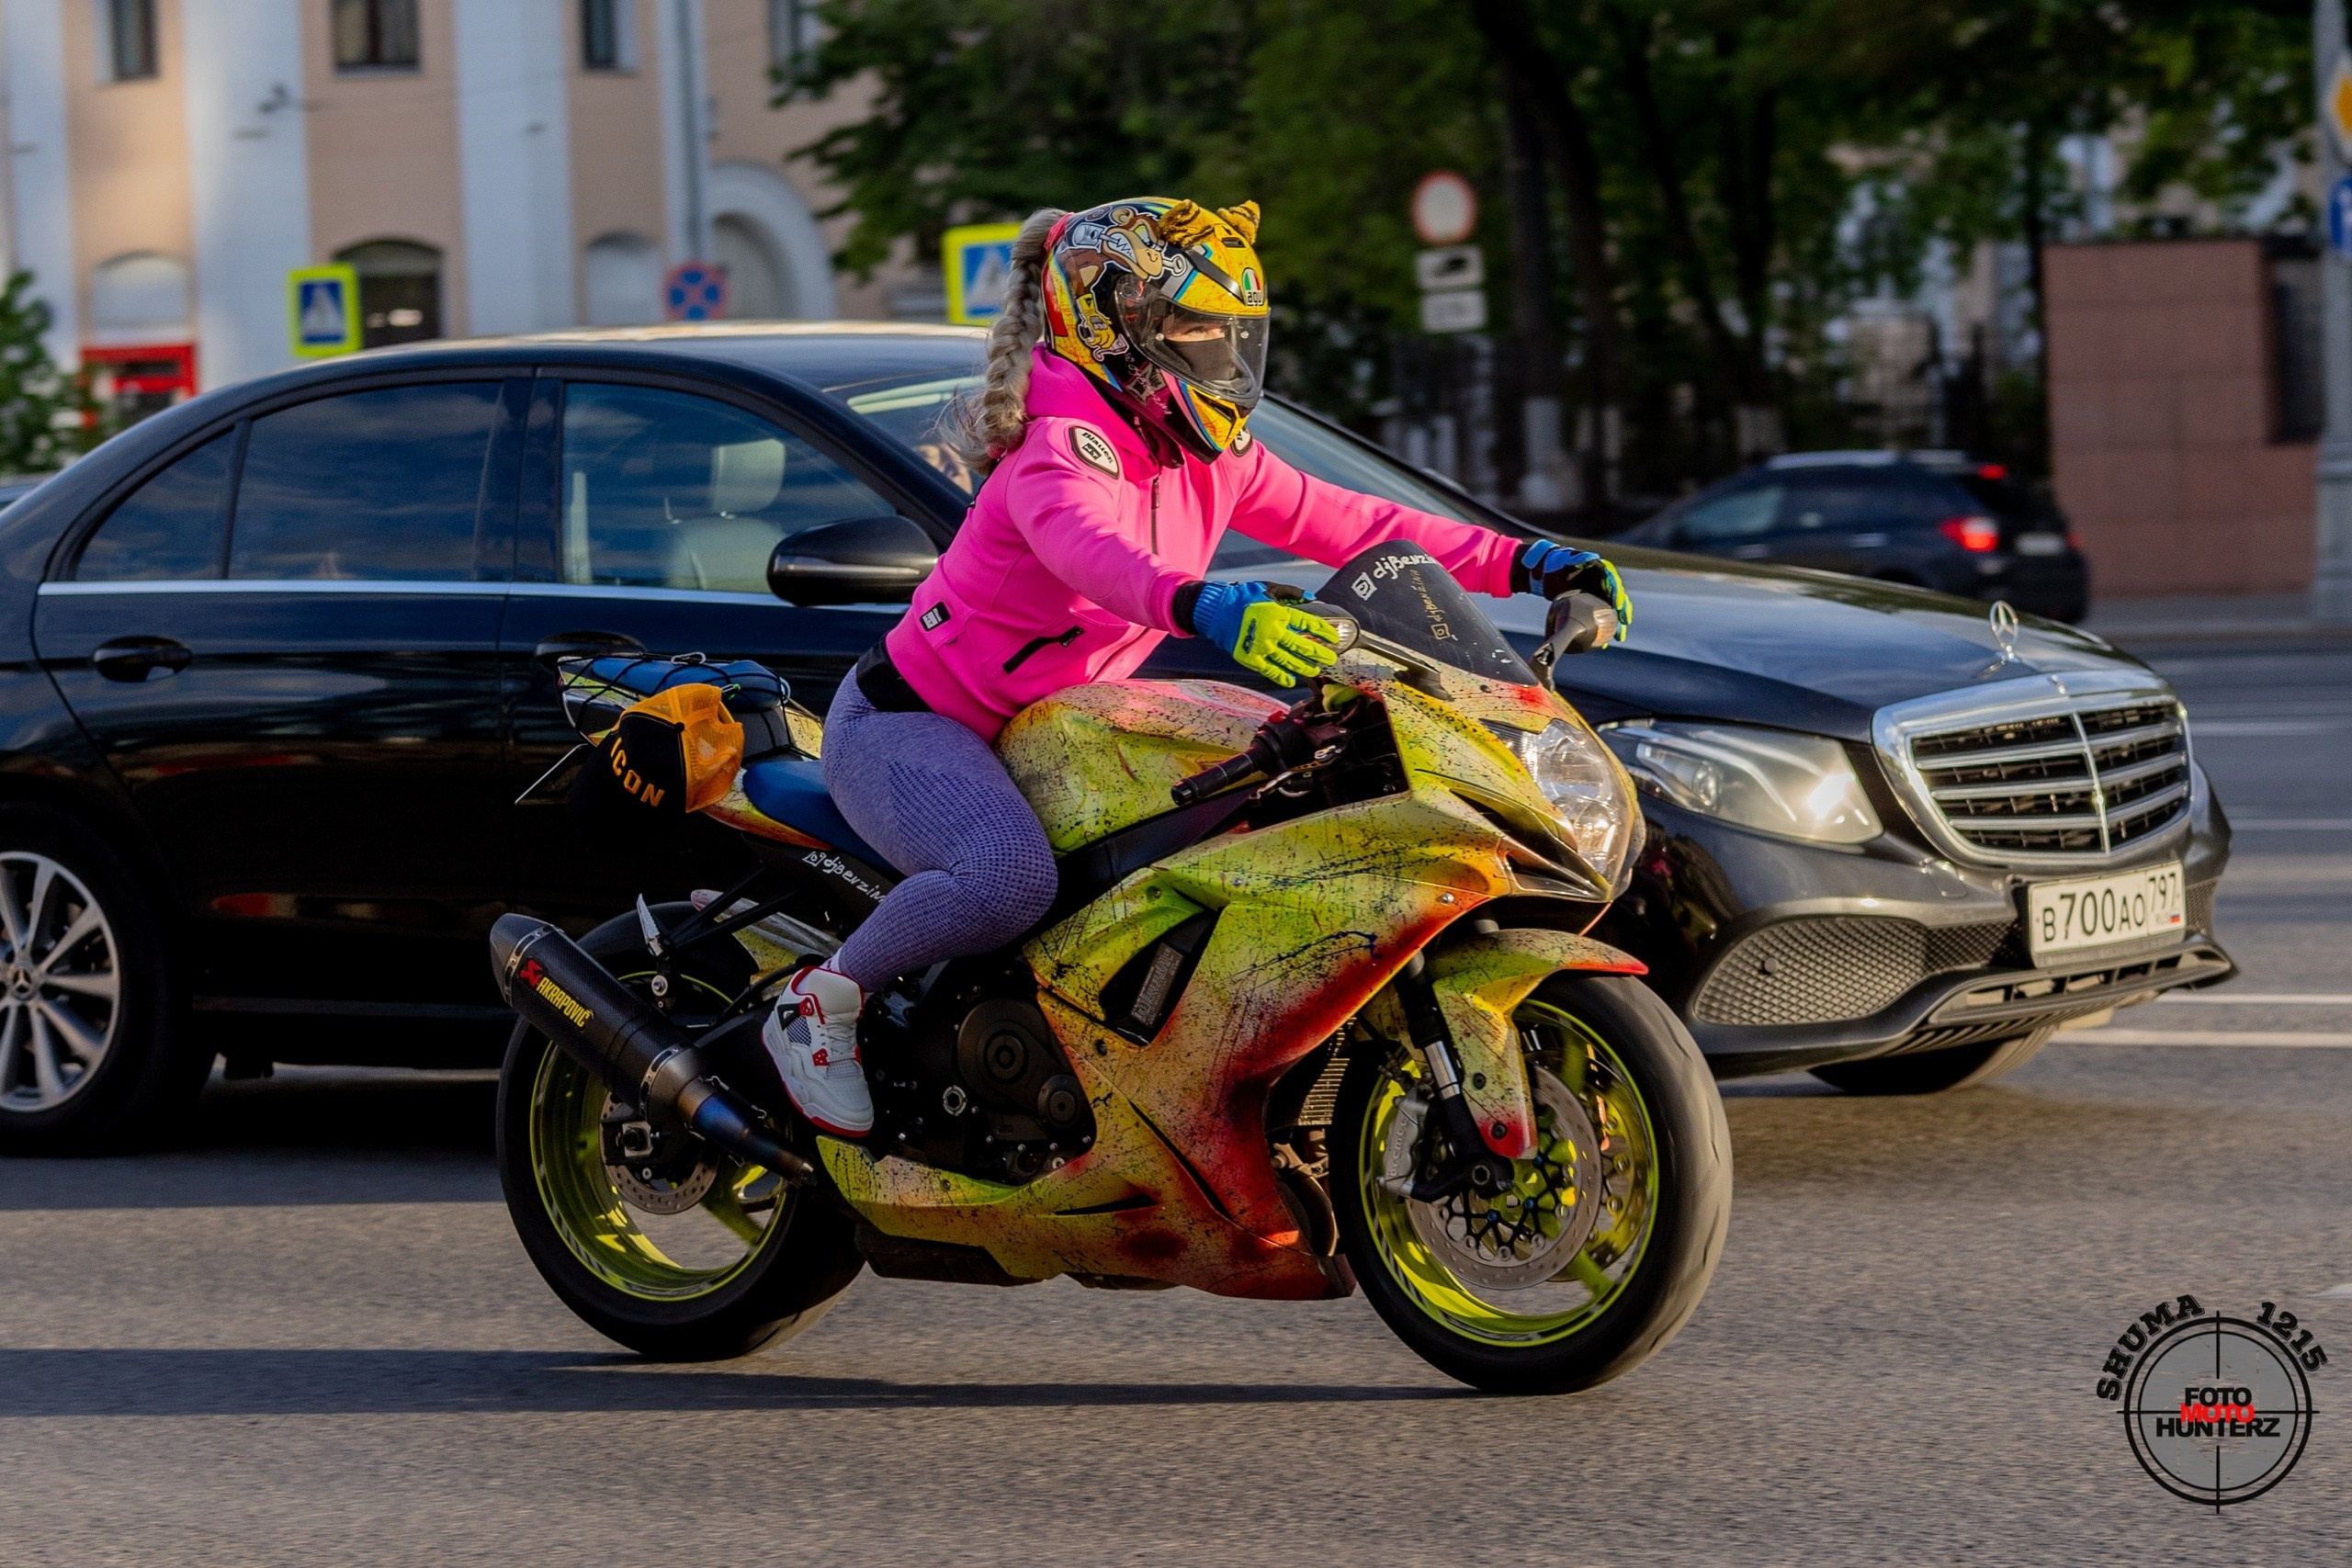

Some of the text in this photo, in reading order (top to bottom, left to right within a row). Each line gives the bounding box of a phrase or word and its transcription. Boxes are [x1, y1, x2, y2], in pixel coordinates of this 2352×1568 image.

[1081, 432, 1114, 464] Blauer
[610, 737, 665, 807] ICON
[2148, 873, 2177, 911] 797
